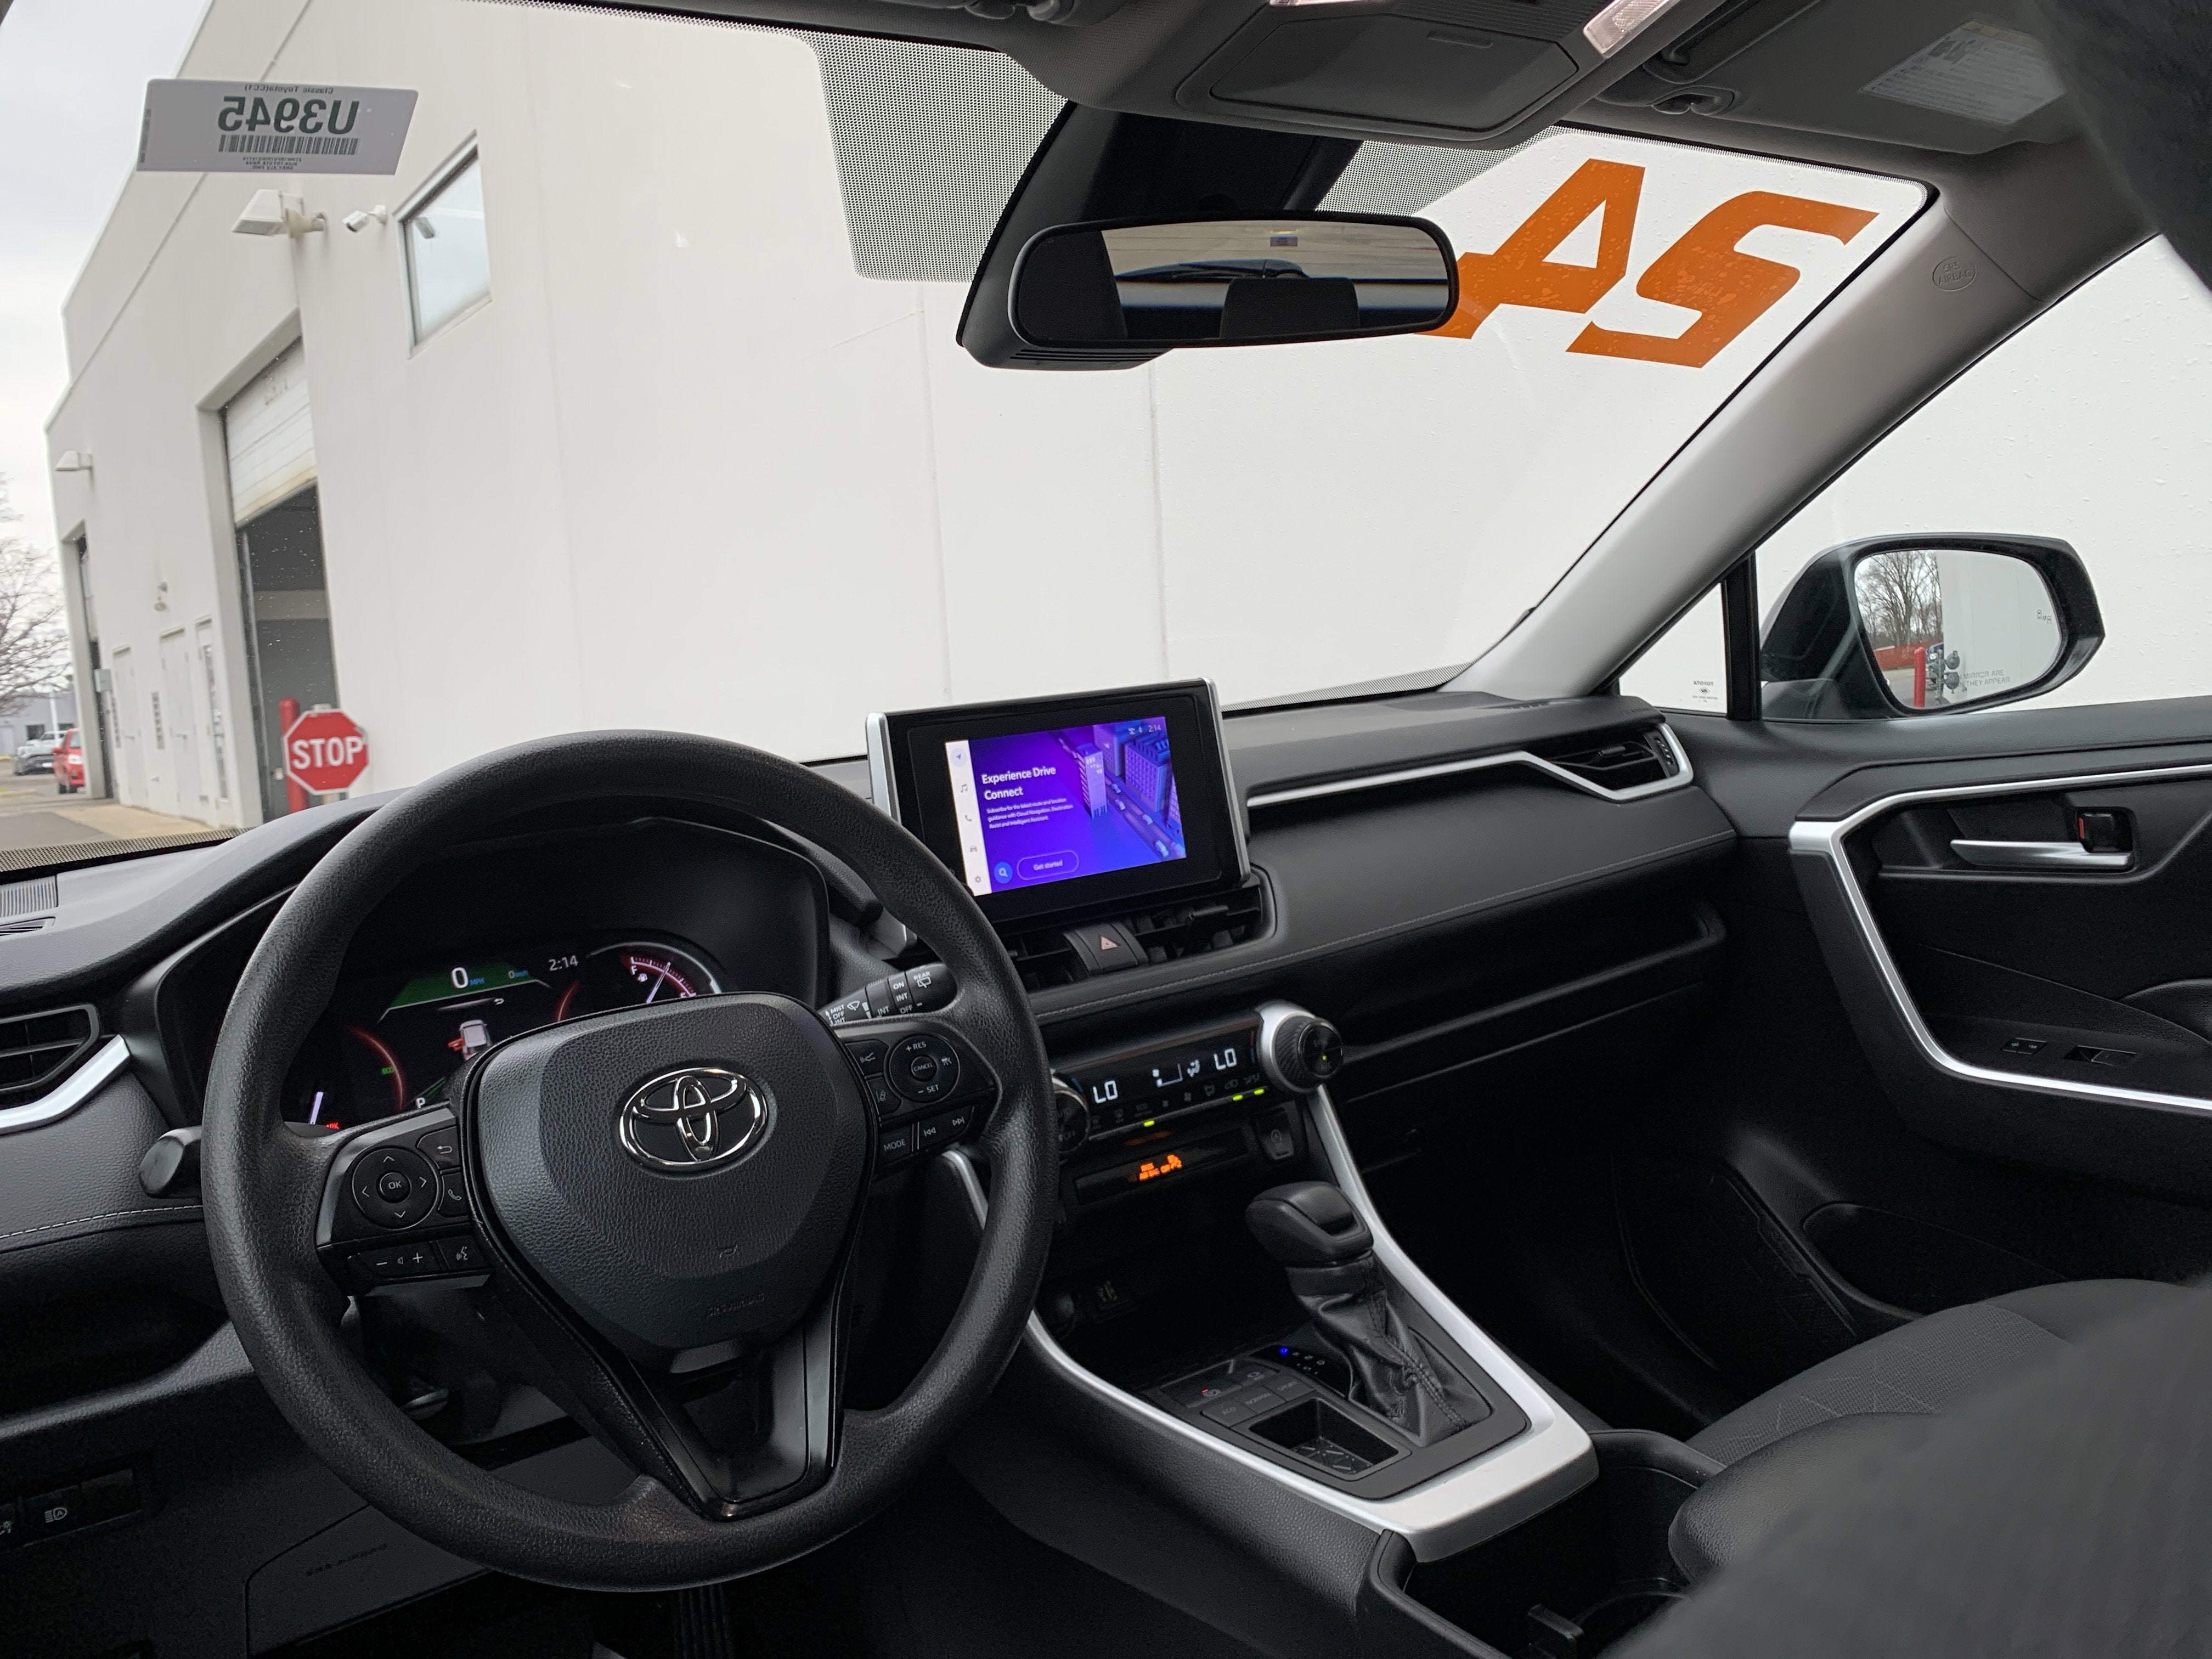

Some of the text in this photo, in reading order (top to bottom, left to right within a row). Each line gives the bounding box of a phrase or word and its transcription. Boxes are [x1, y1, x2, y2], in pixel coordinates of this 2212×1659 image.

[1943, 261, 1961, 273] SRS
[1938, 269, 1972, 285] AIRBAG
[1984, 676, 2010, 685] APPEAR
[1148, 724, 1161, 733] 2:14
[292, 736, 364, 770] STOP
[981, 766, 1056, 785] Experience Drive
[984, 786, 1024, 800] Connect
[1045, 860, 1063, 868] started
[549, 955, 579, 972] 2:14
[631, 965, 637, 975] F
[451, 967, 469, 989] 0
[913, 971, 930, 980] REAR
[893, 981, 905, 990] ON
[896, 992, 908, 1002] INT
[830, 1004, 845, 1014] MIST
[878, 1005, 889, 1015] INT
[900, 1005, 913, 1014] OFF
[833, 1011, 844, 1019] OFF
[913, 1041, 927, 1050] RES
[1214, 1048, 1237, 1071] LO
[913, 1063, 933, 1071] CANCEL
[926, 1084, 939, 1093] SET
[1092, 1080, 1119, 1104] LO
[416, 1097, 426, 1108] P
[884, 1139, 907, 1151] MODE
[388, 1180, 402, 1190] OK
